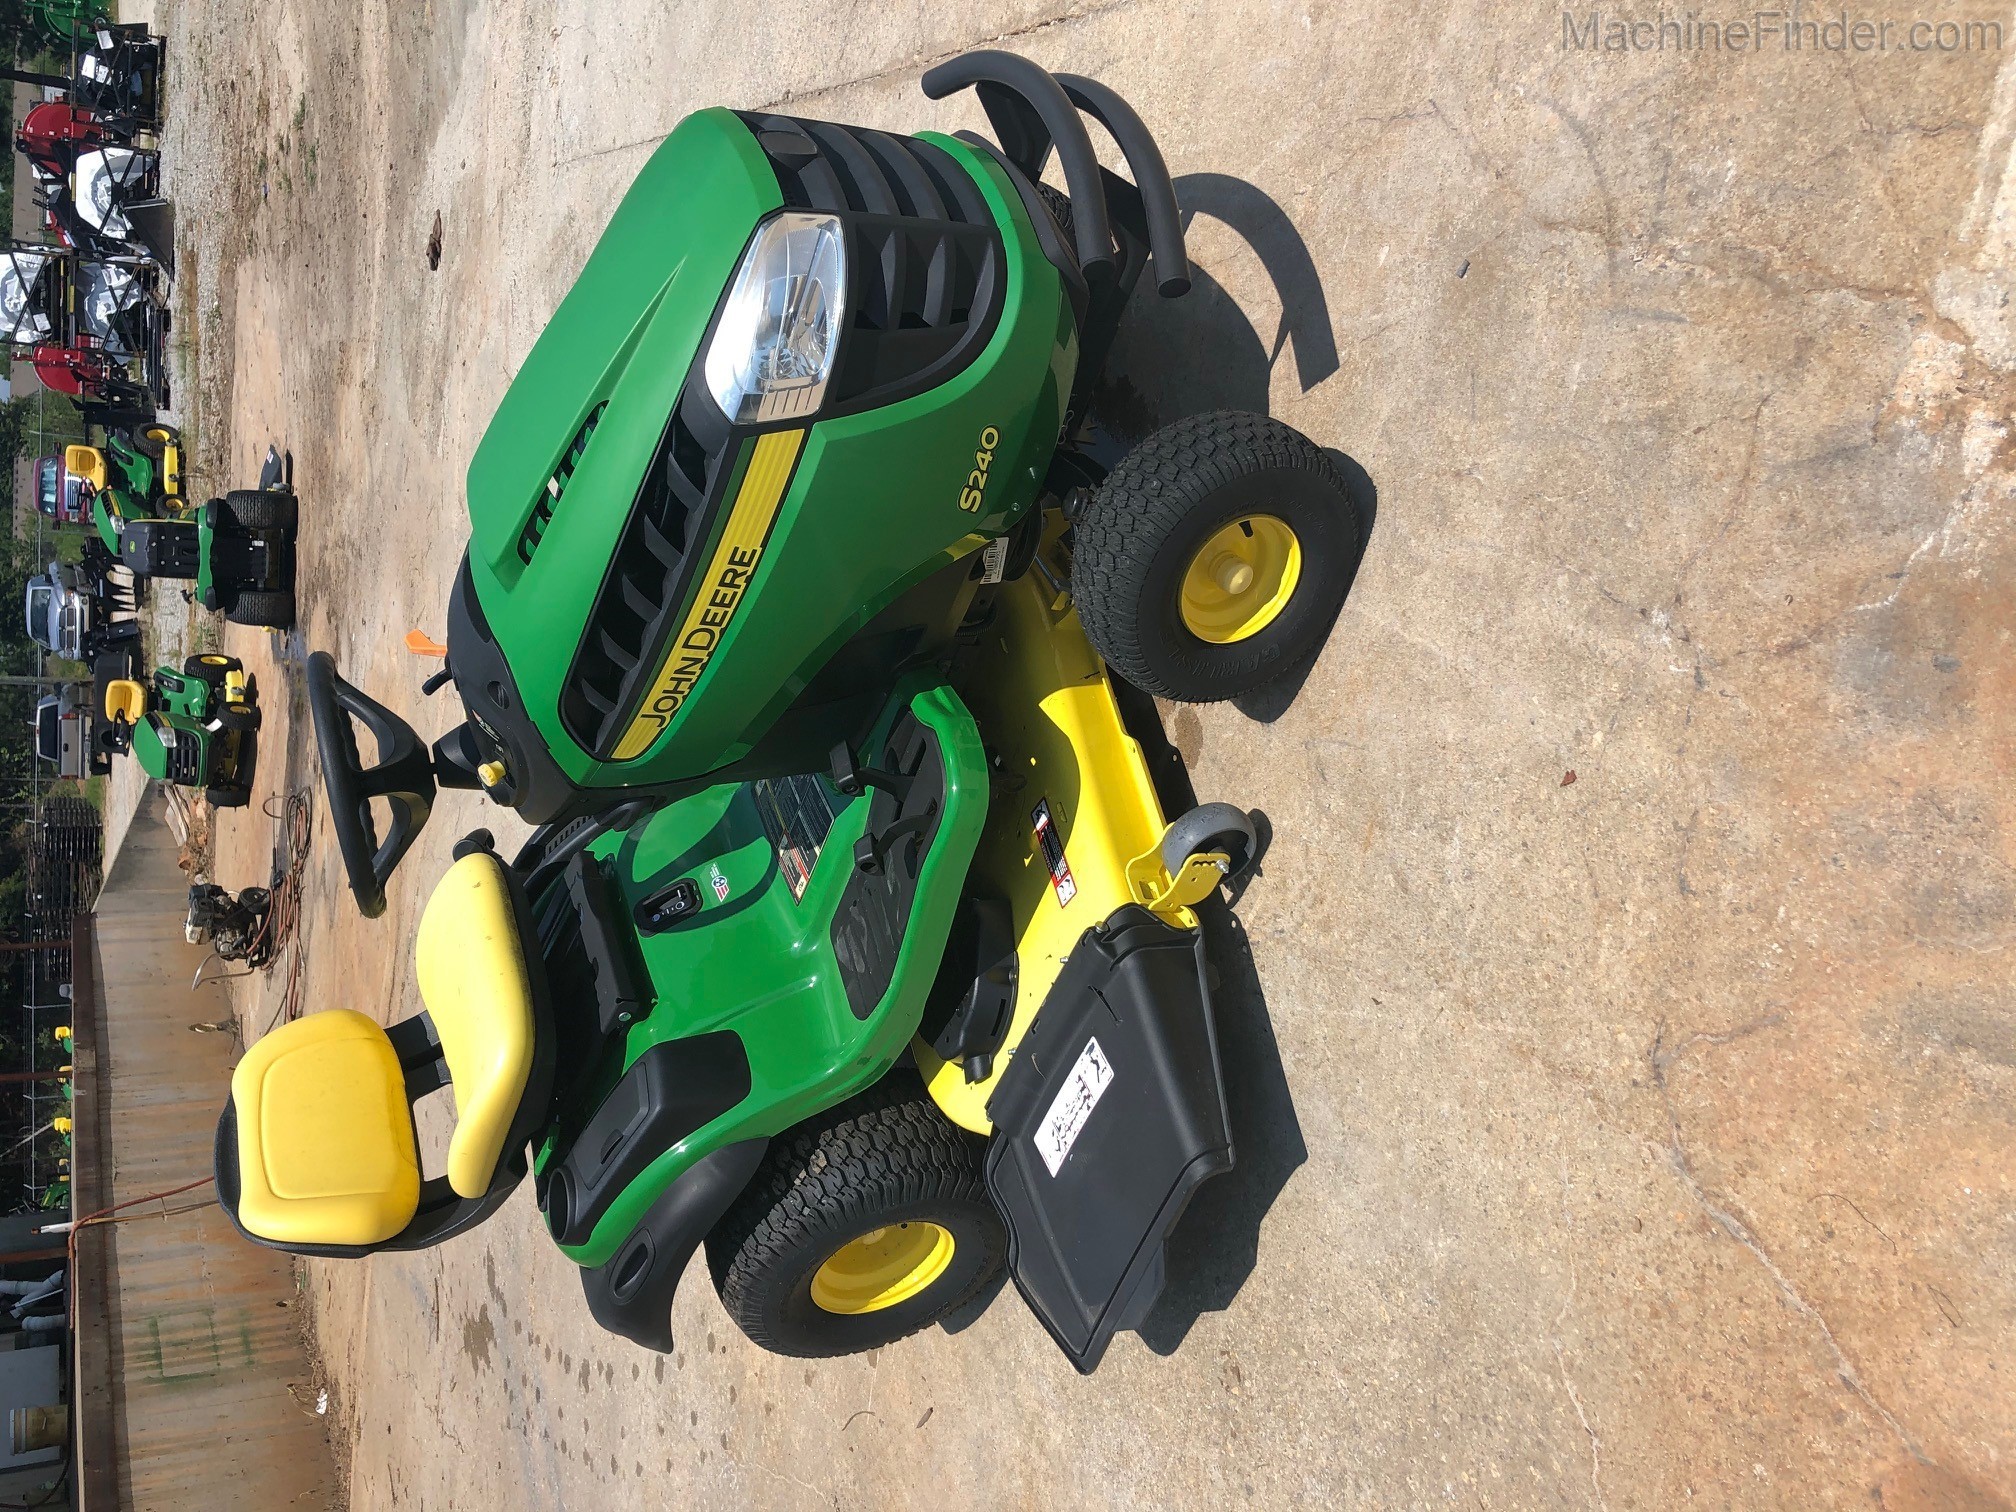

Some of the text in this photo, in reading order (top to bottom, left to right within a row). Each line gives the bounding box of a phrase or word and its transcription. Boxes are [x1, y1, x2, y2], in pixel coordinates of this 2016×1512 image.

[959, 426, 999, 513] S240
[640, 546, 758, 728] JOHN DEERE
